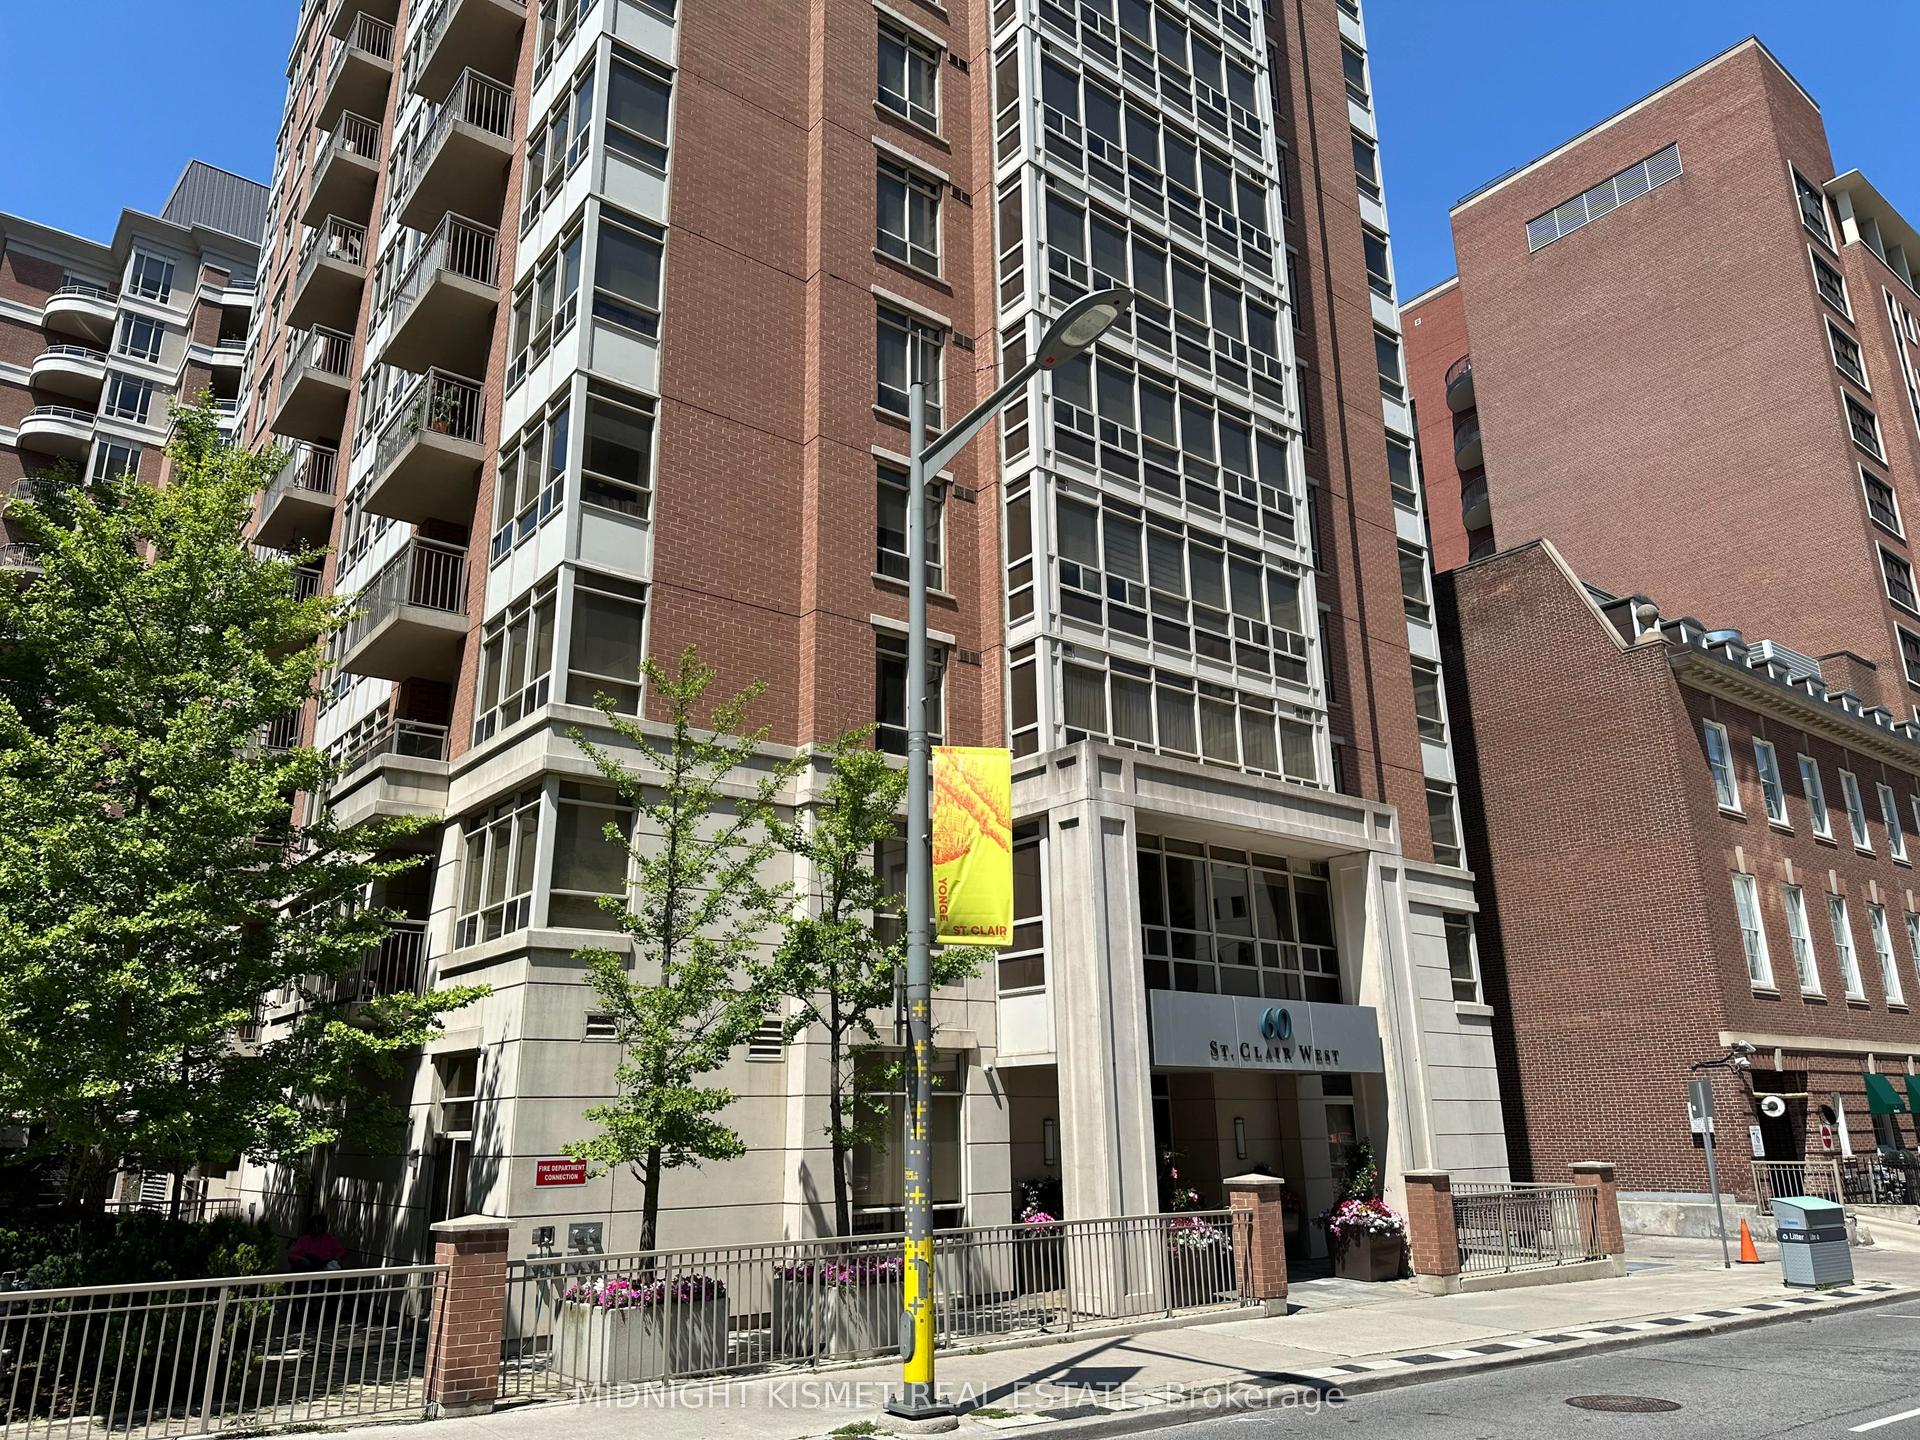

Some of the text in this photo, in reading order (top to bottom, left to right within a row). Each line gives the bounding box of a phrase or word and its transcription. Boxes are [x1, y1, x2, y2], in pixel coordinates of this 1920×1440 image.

[938, 878, 948, 922] YONGE
[970, 926, 1007, 936] CLAIR
[1260, 1007, 1293, 1040] 60
[1240, 1042, 1292, 1061] CLAIR
[1299, 1045, 1339, 1064] WEST
[544, 1173, 579, 1181] CONNECTION
[1789, 1232, 1804, 1240] Litter
